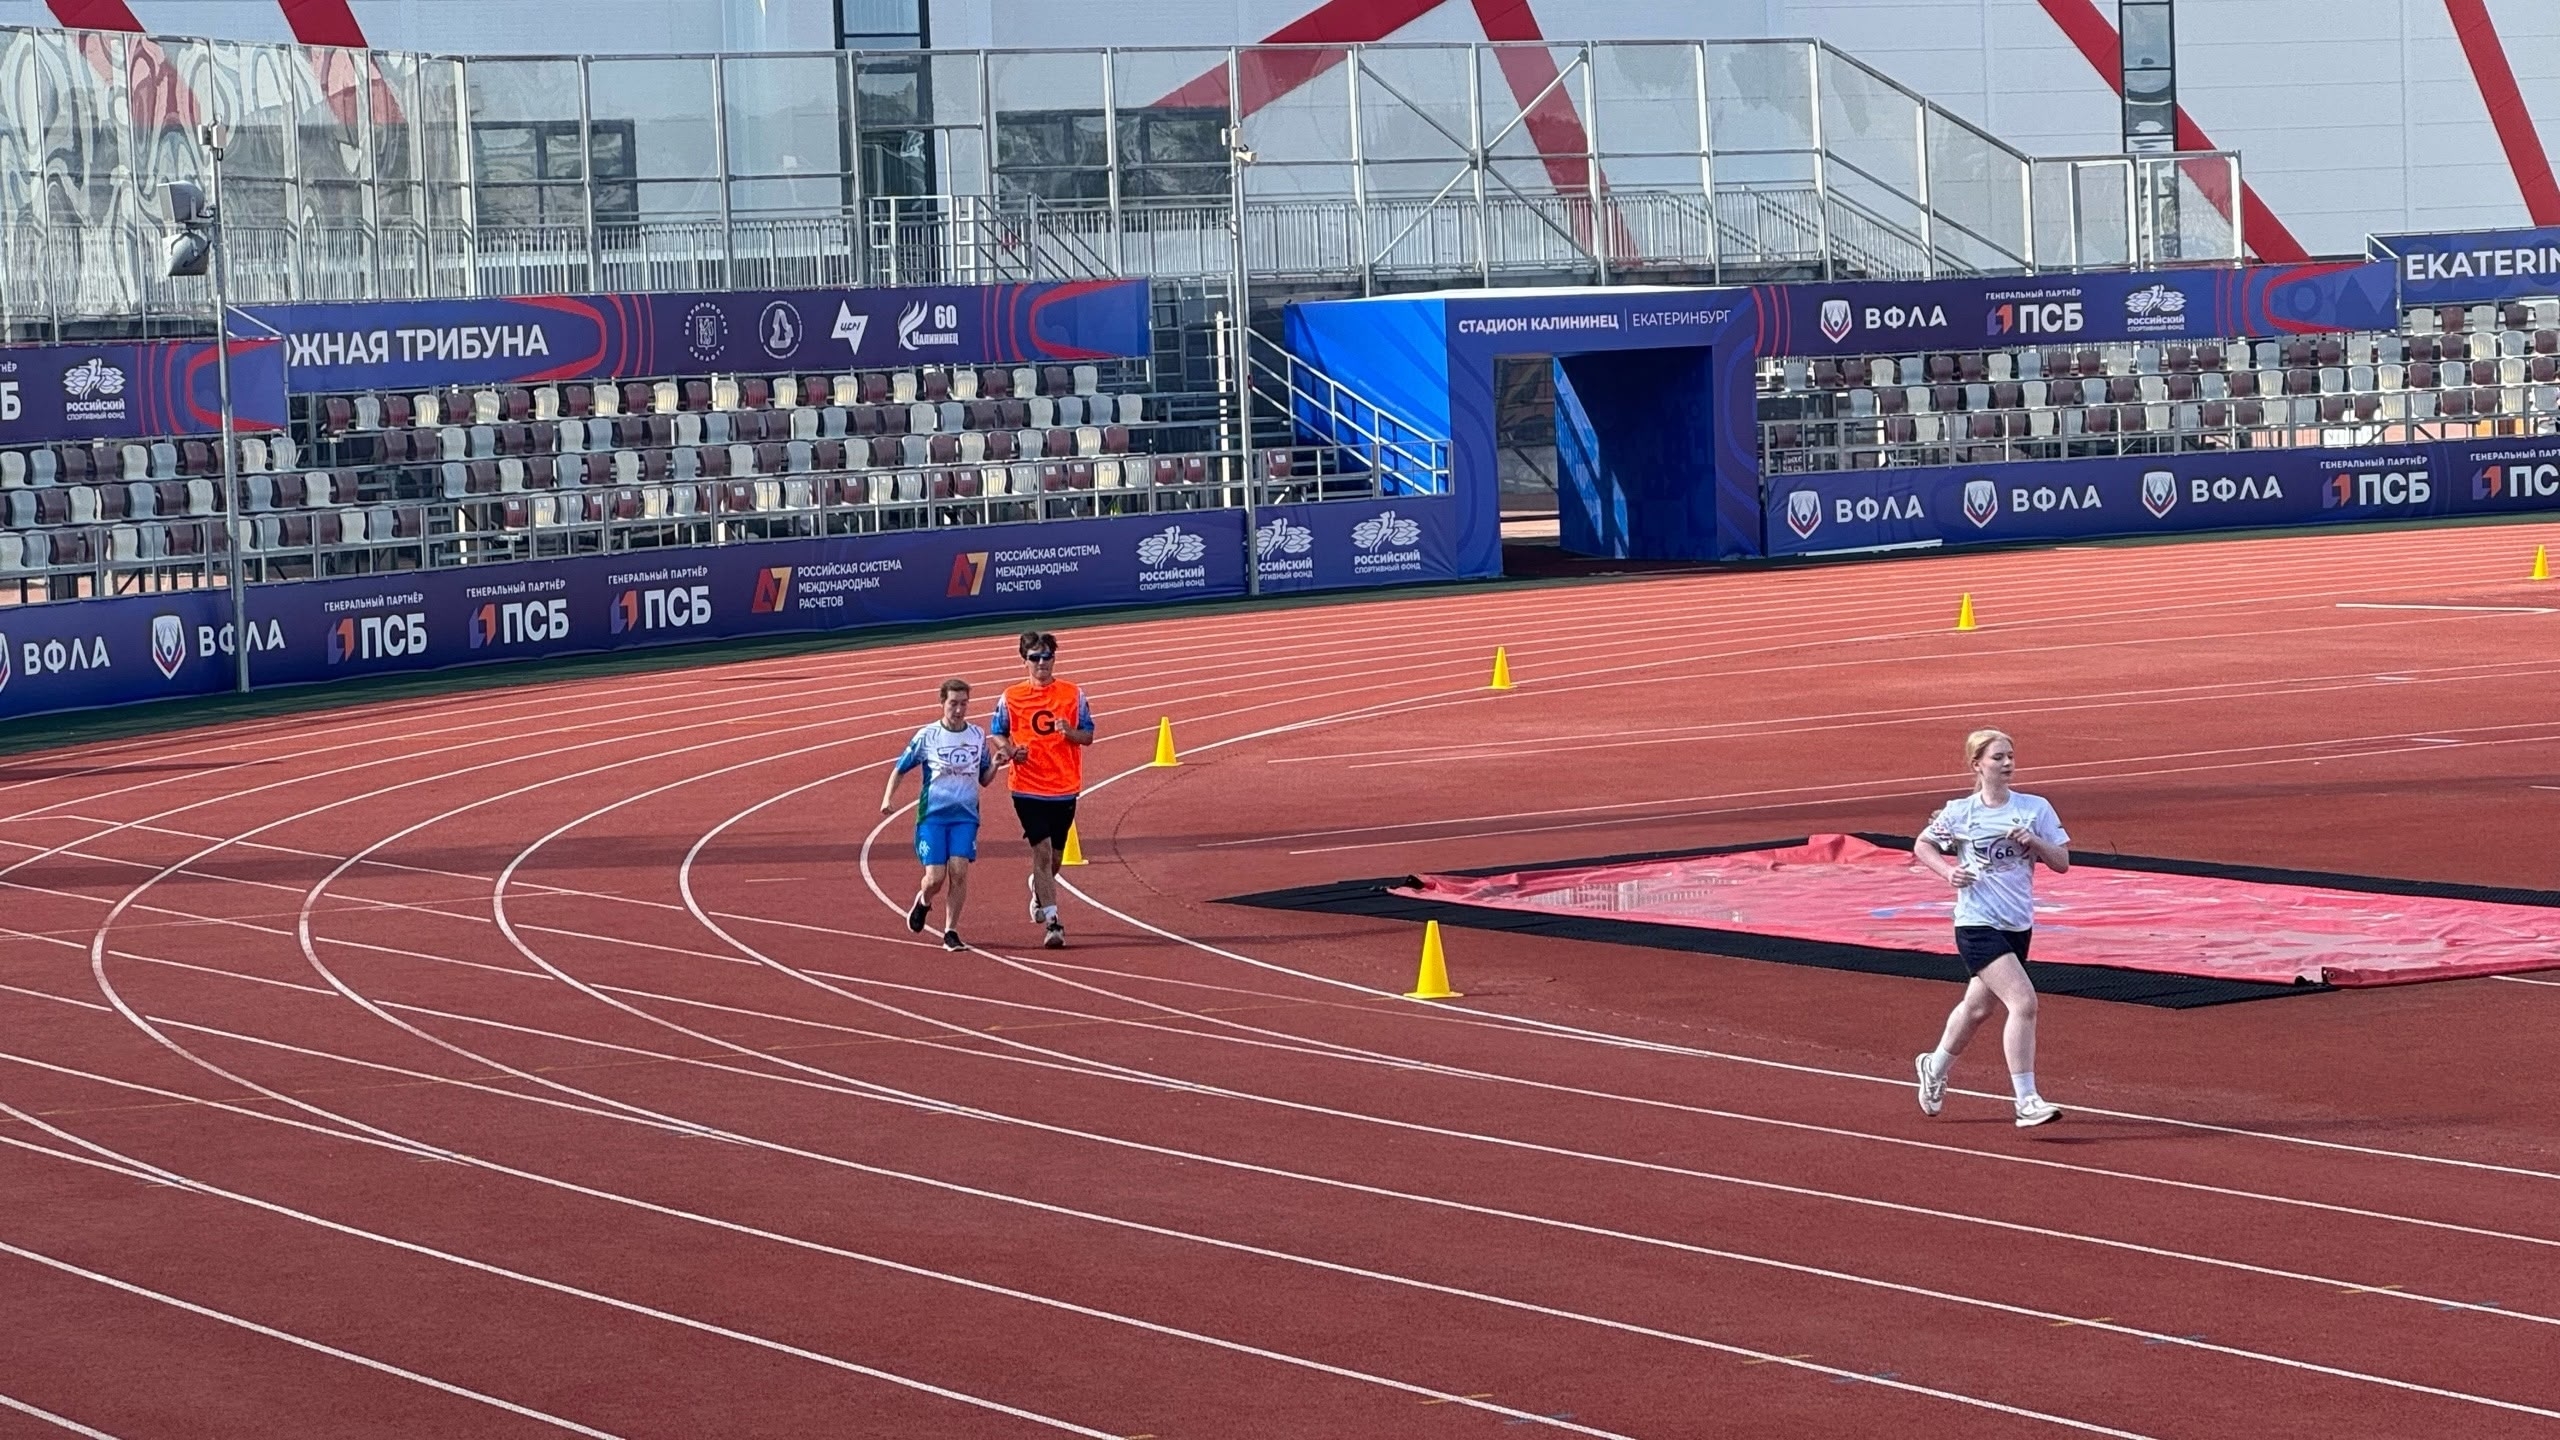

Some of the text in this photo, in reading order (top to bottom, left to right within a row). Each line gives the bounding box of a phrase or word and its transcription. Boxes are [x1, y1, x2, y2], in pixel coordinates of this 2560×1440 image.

[1986, 288, 2081, 300] ГЕНЕРАЛЬНЫЙ ПАРТНЁР
[935, 305, 956, 329] 60
[1459, 310, 1730, 334] СТАДИОН КАЛИНИНЕЦ ЕКАТЕРИНБУРГ
[1866, 306, 1947, 328] ВФЛА
[2020, 303, 2083, 333] ПСБ
[2128, 313, 2184, 325] РОССИЙСКИЙ
[286, 325, 549, 367] ЖНАЯ ТРИБУНА
[0, 361, 17, 372] НЁР
[1, 382, 21, 420] Б
[67, 398, 125, 412] РОССИЙСКИЙ
[67, 411, 125, 420] СПОРТИВНЫЙ ФОНД
[2320, 456, 2427, 469] ГЕНЕРАЛЬНЫЙ ПАРТНЁР
[2470, 449, 2536, 461] ГЕНЕРАЛЬНЫЙ
[2192, 476, 2282, 502] ВФЛА
[2359, 472, 2430, 505] ПСБ
[2013, 486, 2101, 512] ВФЛА
[1836, 495, 1924, 523] ВФЛА
[995, 545, 1100, 562] РОССИЙСКАЯ СИСТЕМА
[1354, 549, 1420, 565] РОССИЙСКИЙ
[798, 560, 902, 577] РОССИЙСКАЯ СИСТЕМА
[995, 561, 1079, 577] МЕЖДУНАРОДНЫХ
[1140, 565, 1205, 581] РОССИЙСКИЙ
[1245, 557, 1313, 573] ССИЙСКИЙ
[1355, 562, 1421, 574] СПОРТИВНЫЙ ФОНД
[609, 566, 707, 584] ГЕНЕРАЛЬНЫЙ ПАРТНЁР
[1245, 570, 1313, 580] РТИВНЫЙ ФОНД
[466, 579, 565, 598] ГЕНЕРАЛЬНЫЙ ПАРТНЁР
[799, 577, 880, 594] МЕЖДУНАРОДНЫХ
[996, 580, 1041, 592] РАСЧЕТОВ
[1140, 579, 1205, 591] СПОРТИВНЫЙ ФОНД
[325, 592, 423, 611] ГЕНЕРАЛЬНЫЙ ПАРТНЁР
[645, 586, 711, 629] ПСБ
[799, 596, 843, 609] РАСЧЕТОВ
[503, 599, 569, 643] ПСБ
[361, 613, 427, 658] ПСБ
[24, 636, 110, 675] ВФЛА
[1032, 710, 1056, 735] G
[954, 754, 968, 763] 72
[1995, 846, 2014, 860] 66
